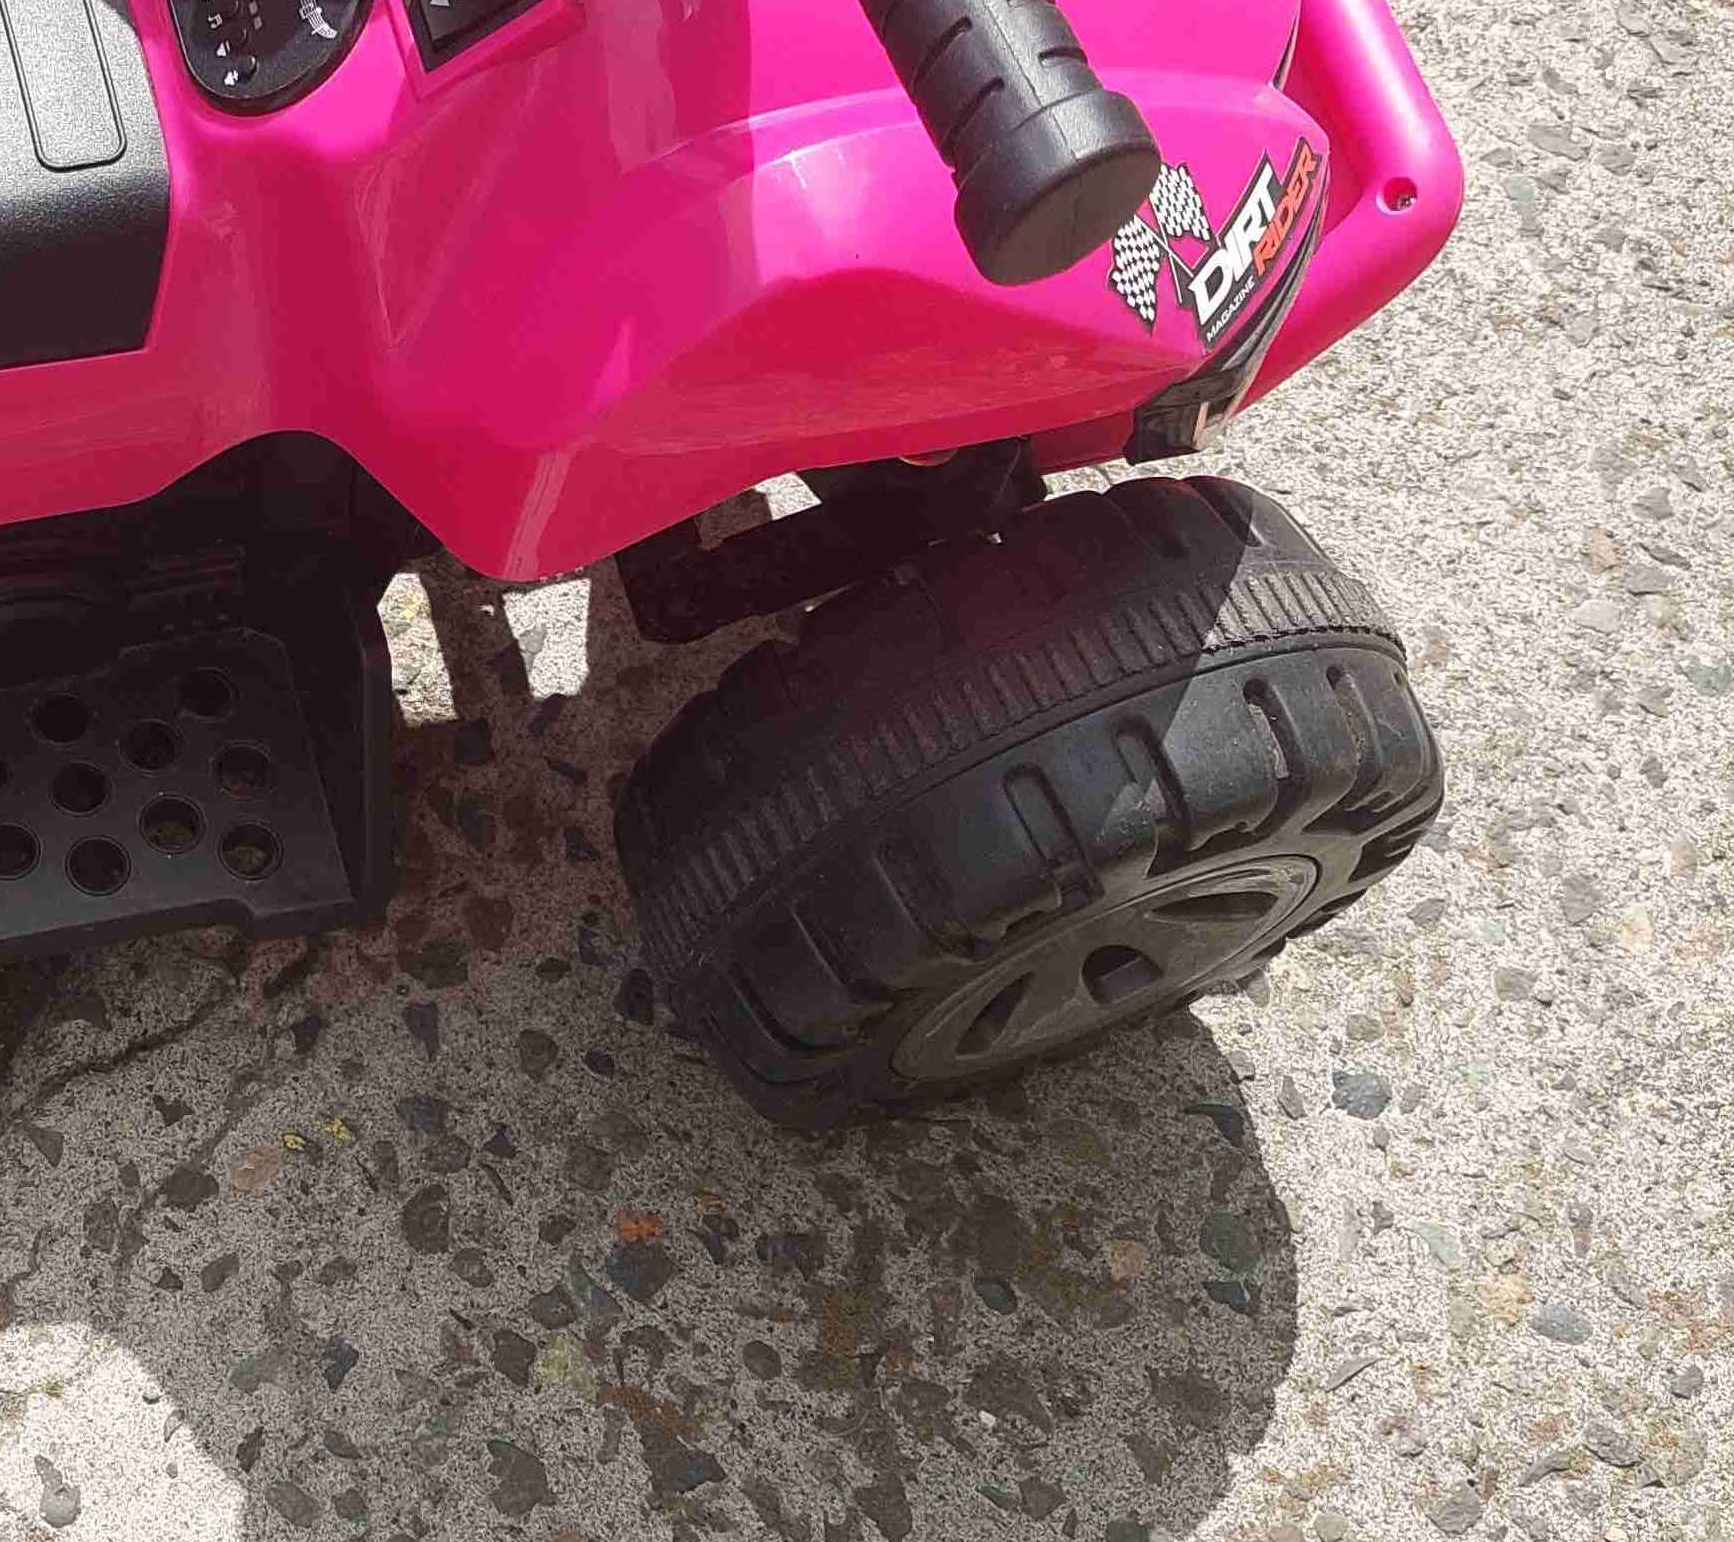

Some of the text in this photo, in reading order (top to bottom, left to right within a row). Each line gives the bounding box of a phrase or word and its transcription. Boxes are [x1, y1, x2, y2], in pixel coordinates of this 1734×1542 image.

[1188, 162, 1276, 326] DIRT
[1252, 143, 1317, 277] RIDER
[1206, 275, 1256, 343] MAGAZINE
